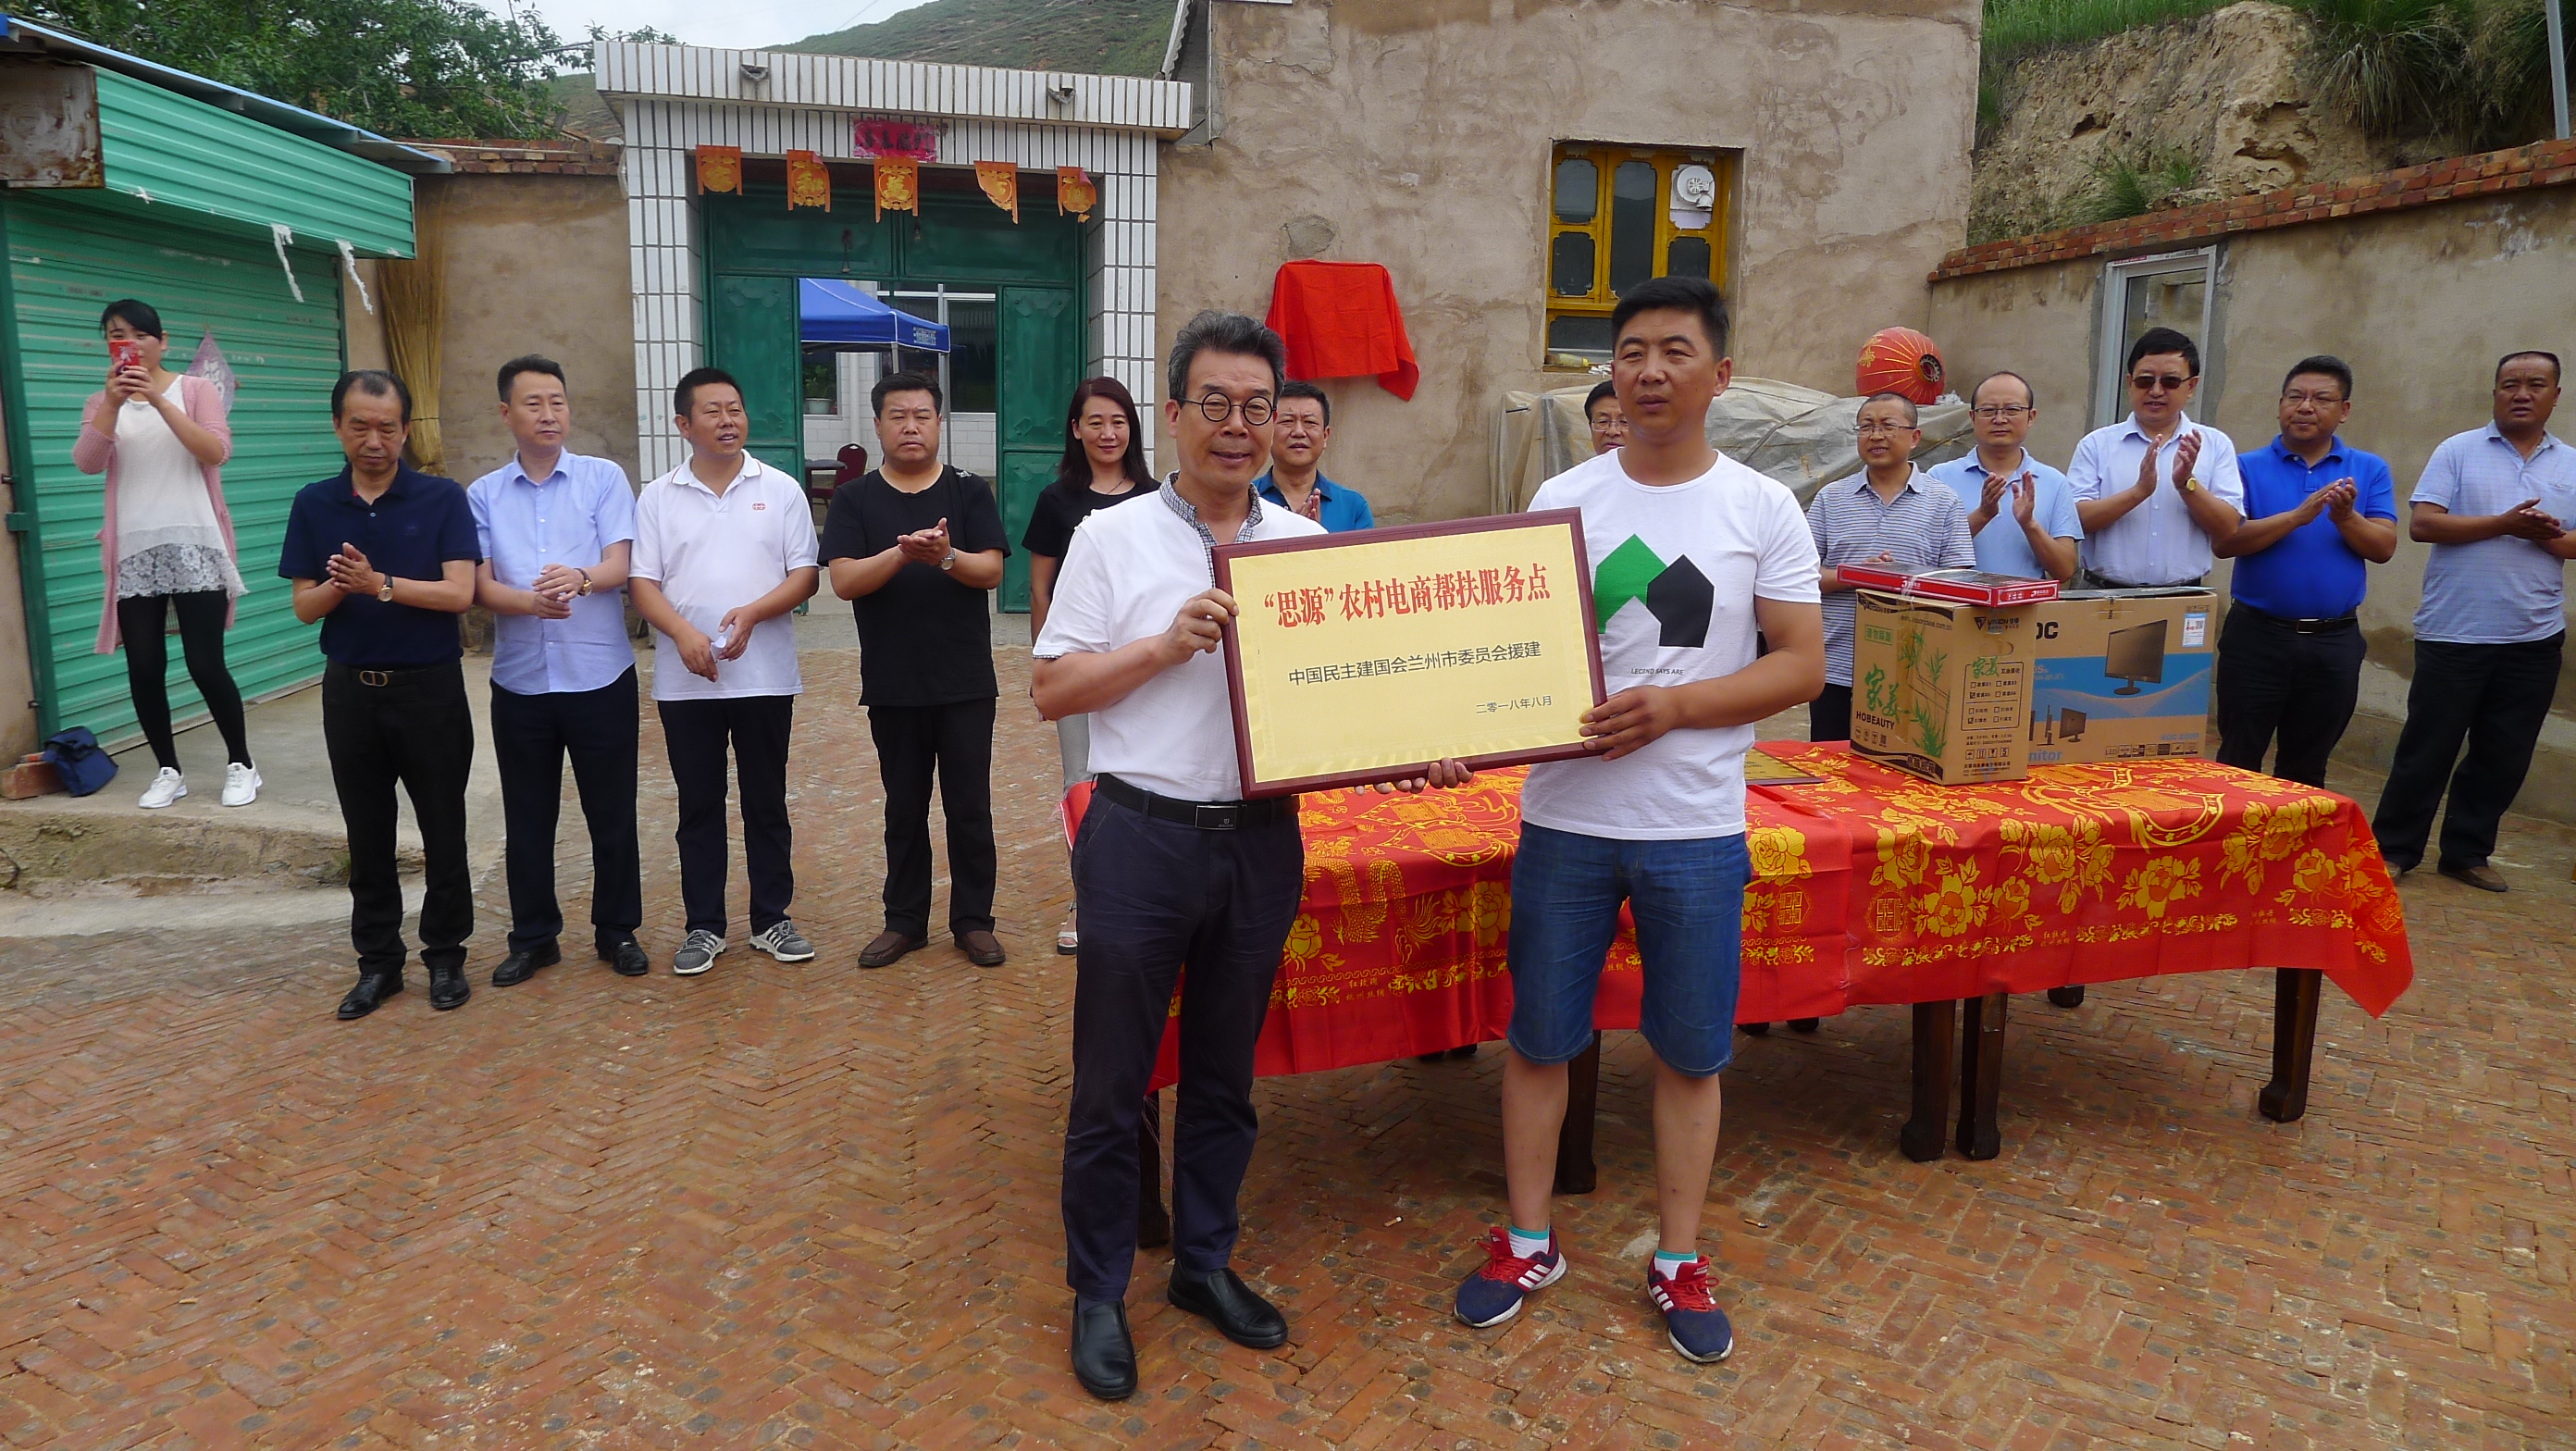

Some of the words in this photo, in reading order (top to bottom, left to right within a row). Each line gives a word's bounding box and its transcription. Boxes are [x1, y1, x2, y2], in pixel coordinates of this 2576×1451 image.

[1264, 563, 1551, 628] “思源”农村电商帮扶服务点
[1289, 640, 1542, 686] 中国民主建国会兰州市委员会援建
[1476, 695, 1552, 714] 二零一八年八月
[1856, 711, 1896, 730] HOBEAUTY
[2028, 749, 2063, 762] nitor
